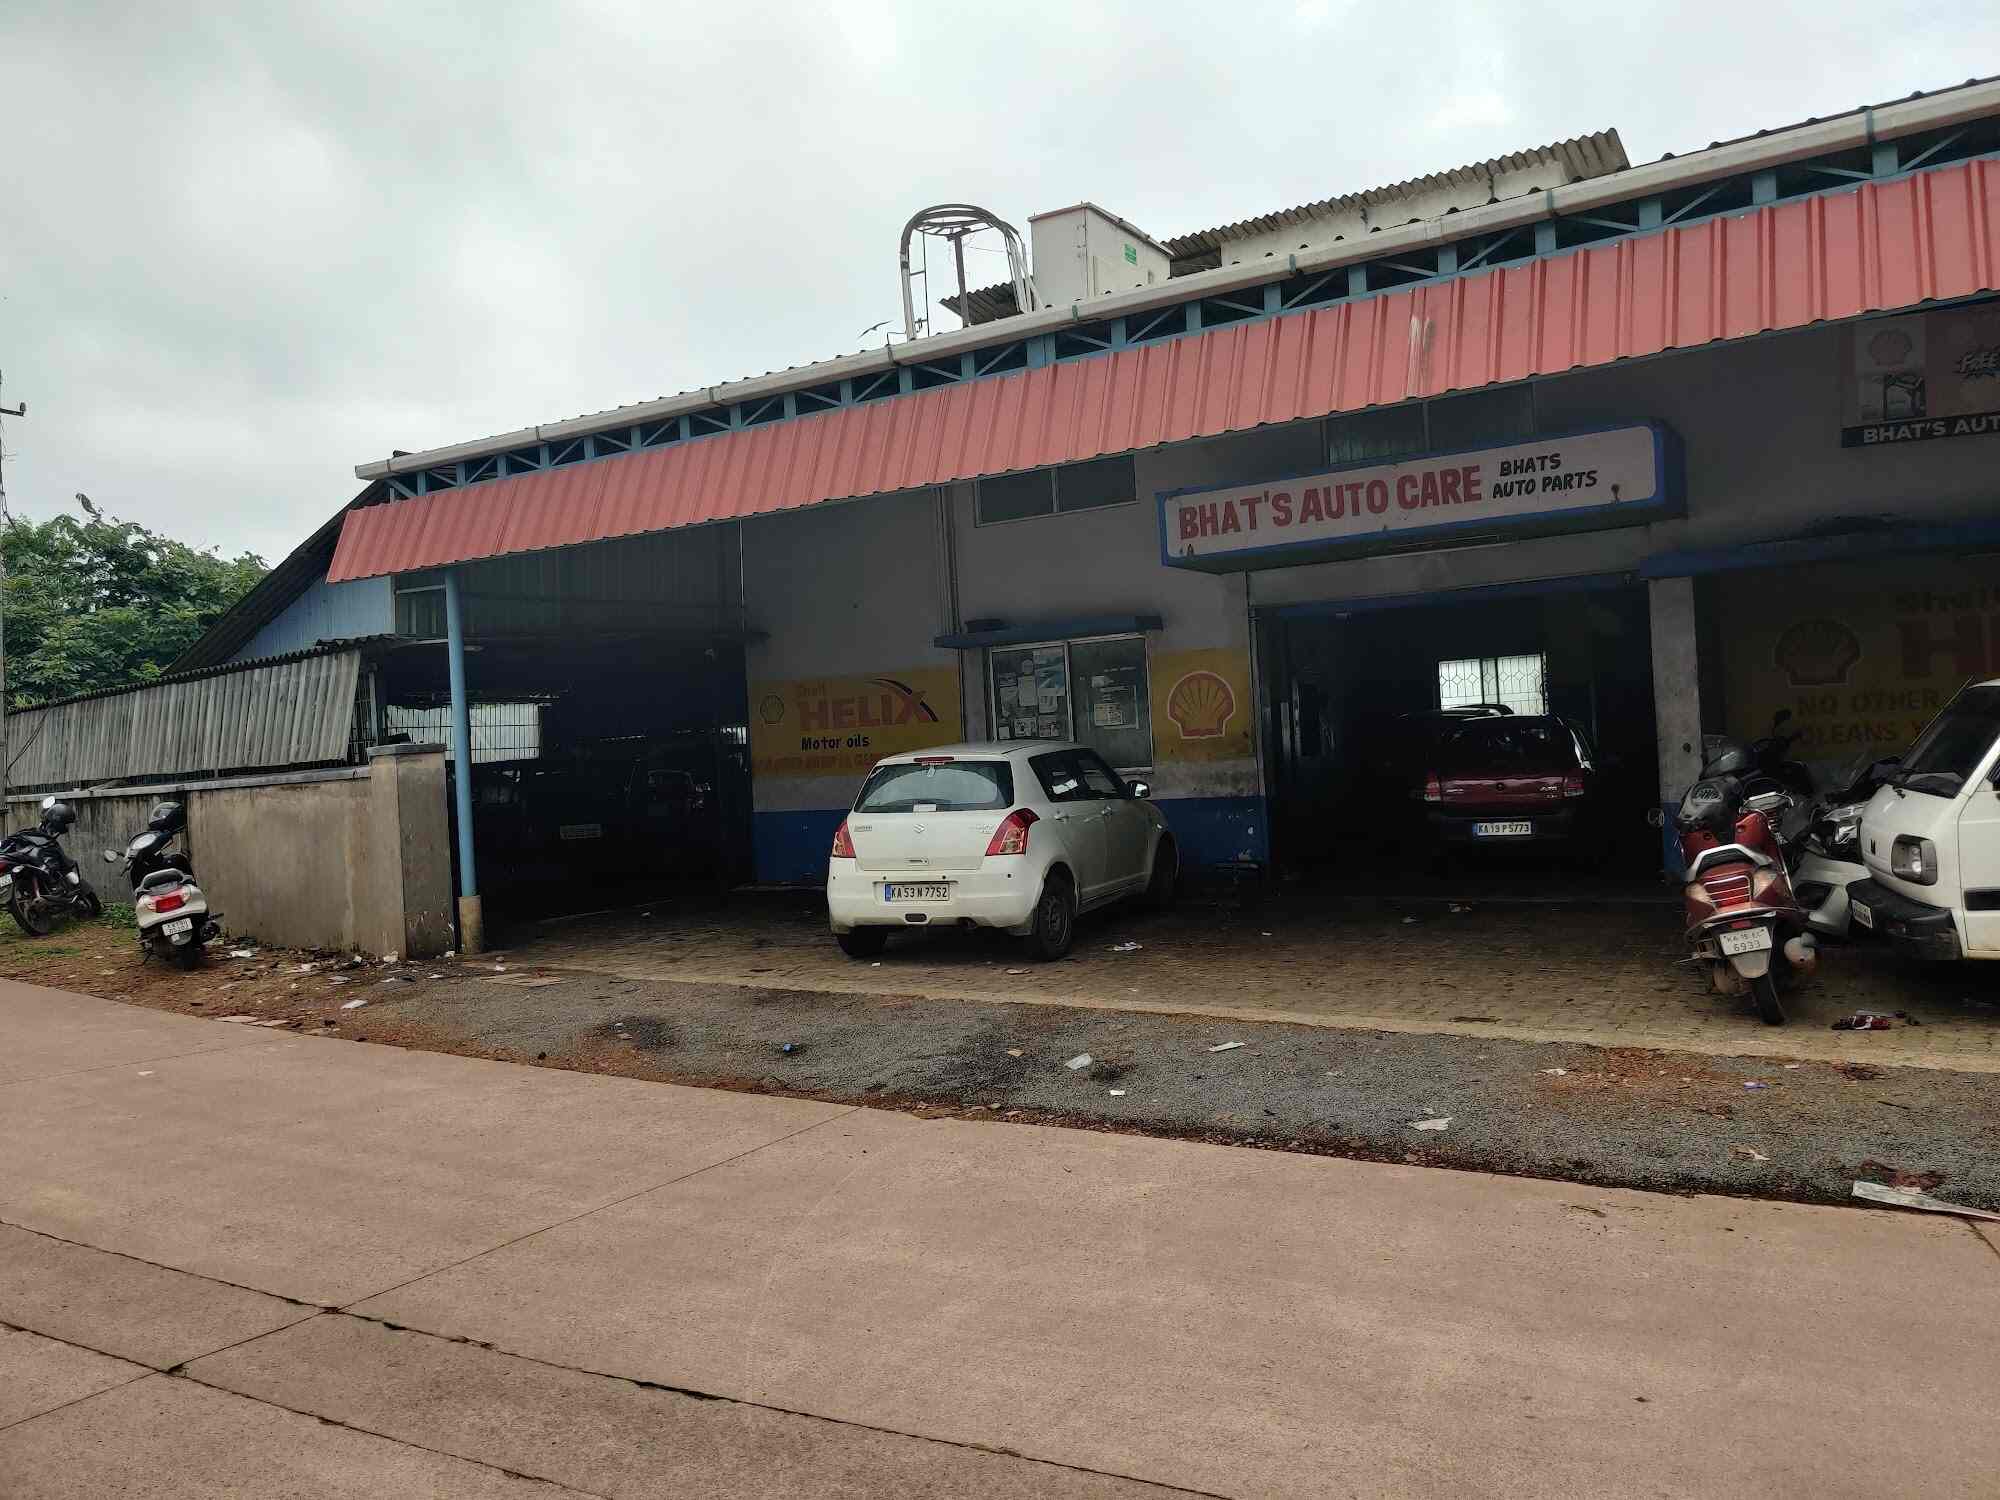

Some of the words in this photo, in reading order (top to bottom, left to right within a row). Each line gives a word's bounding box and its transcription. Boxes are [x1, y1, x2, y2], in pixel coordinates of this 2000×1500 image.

[1863, 420, 1946, 444] BHAT'S
[1499, 452, 1562, 477] BHATS
[1492, 477, 1537, 500] AUTO
[1541, 470, 1599, 493] PARTS
[1178, 489, 1293, 541] BHAT'S
[1299, 478, 1390, 524] AUTO
[1397, 464, 1483, 511] CARE
[797, 690, 926, 732] HELIX
[1796, 692, 1836, 718] NO
[1849, 686, 1939, 714] OTHER
[801, 737, 841, 751] Motor
[847, 734, 870, 749] oils
